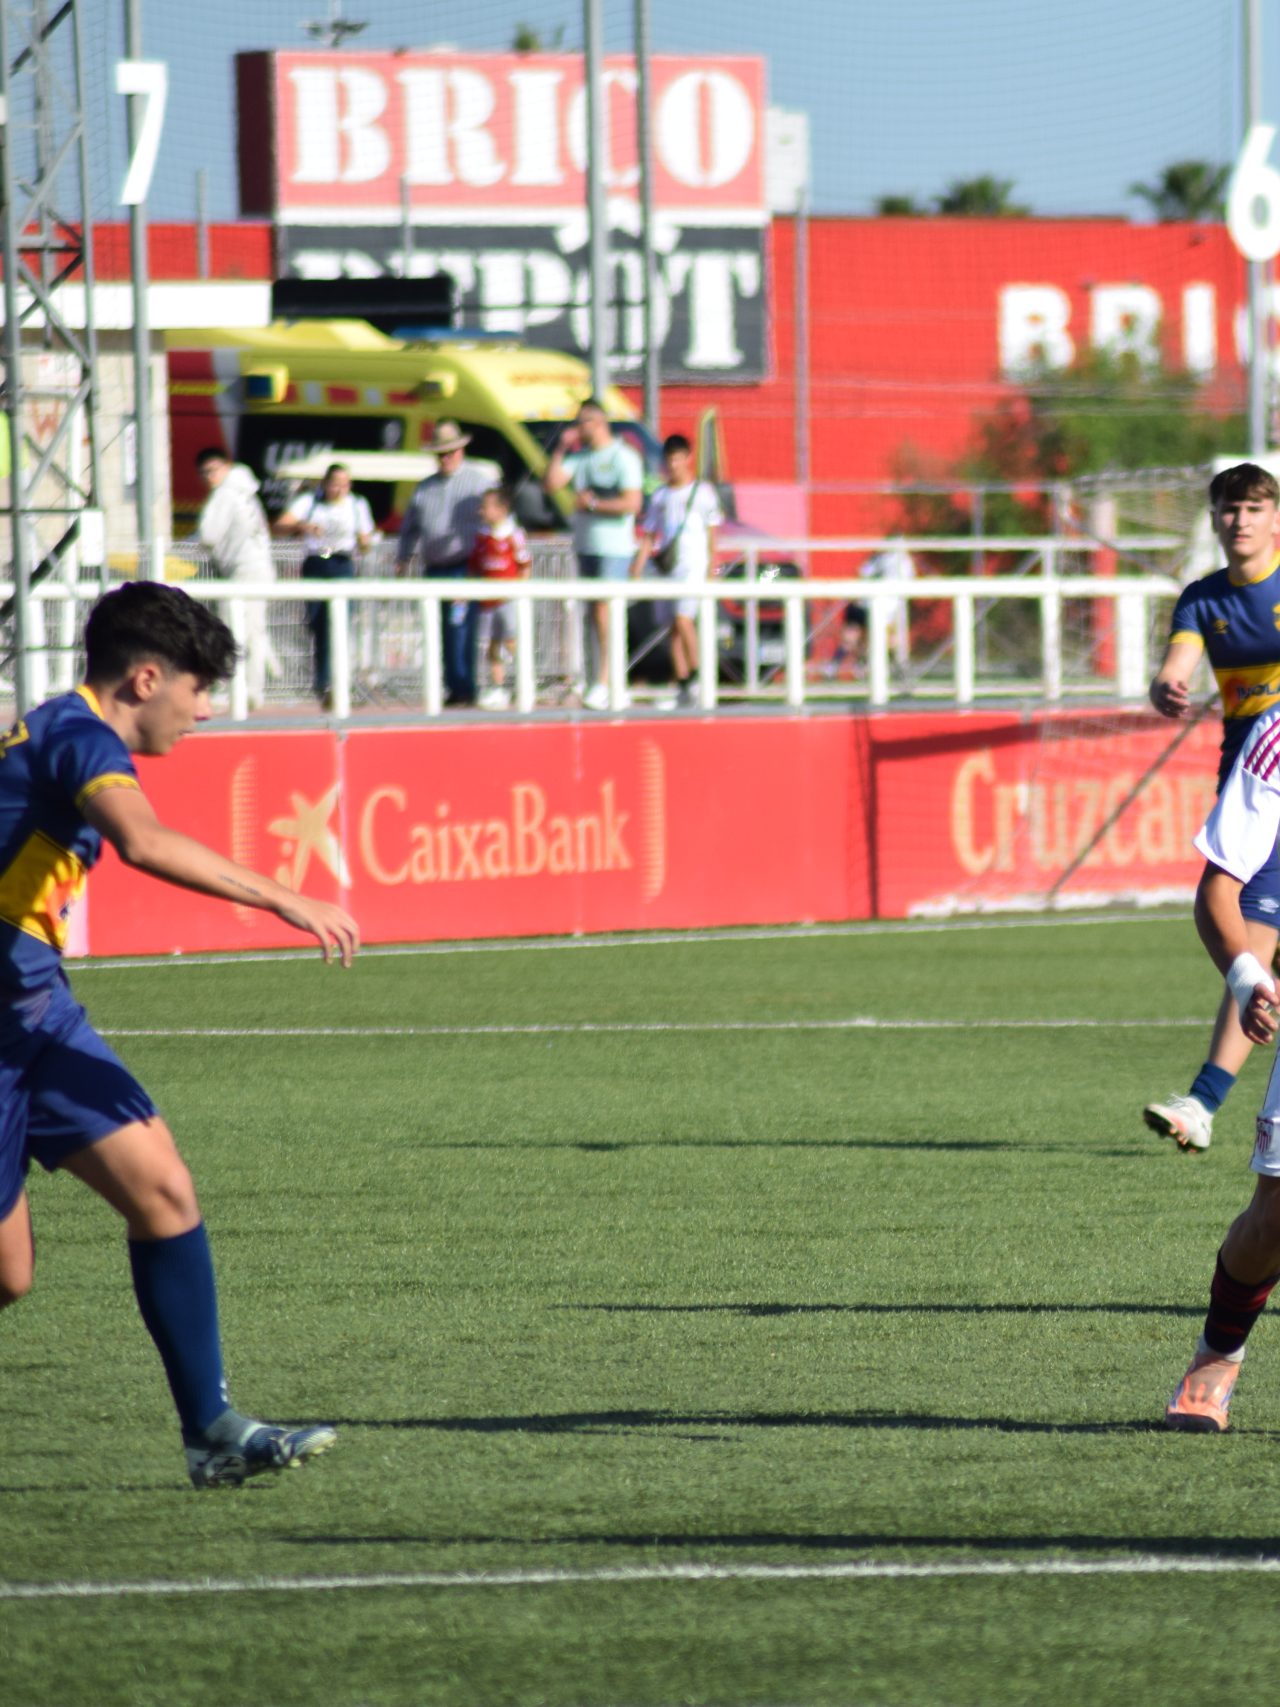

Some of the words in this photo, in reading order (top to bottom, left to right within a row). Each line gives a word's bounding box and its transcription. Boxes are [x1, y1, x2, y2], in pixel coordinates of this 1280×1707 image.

[117, 62, 168, 205] 7
[288, 66, 755, 188] BRICO
[360, 780, 631, 885] CaixaBank
